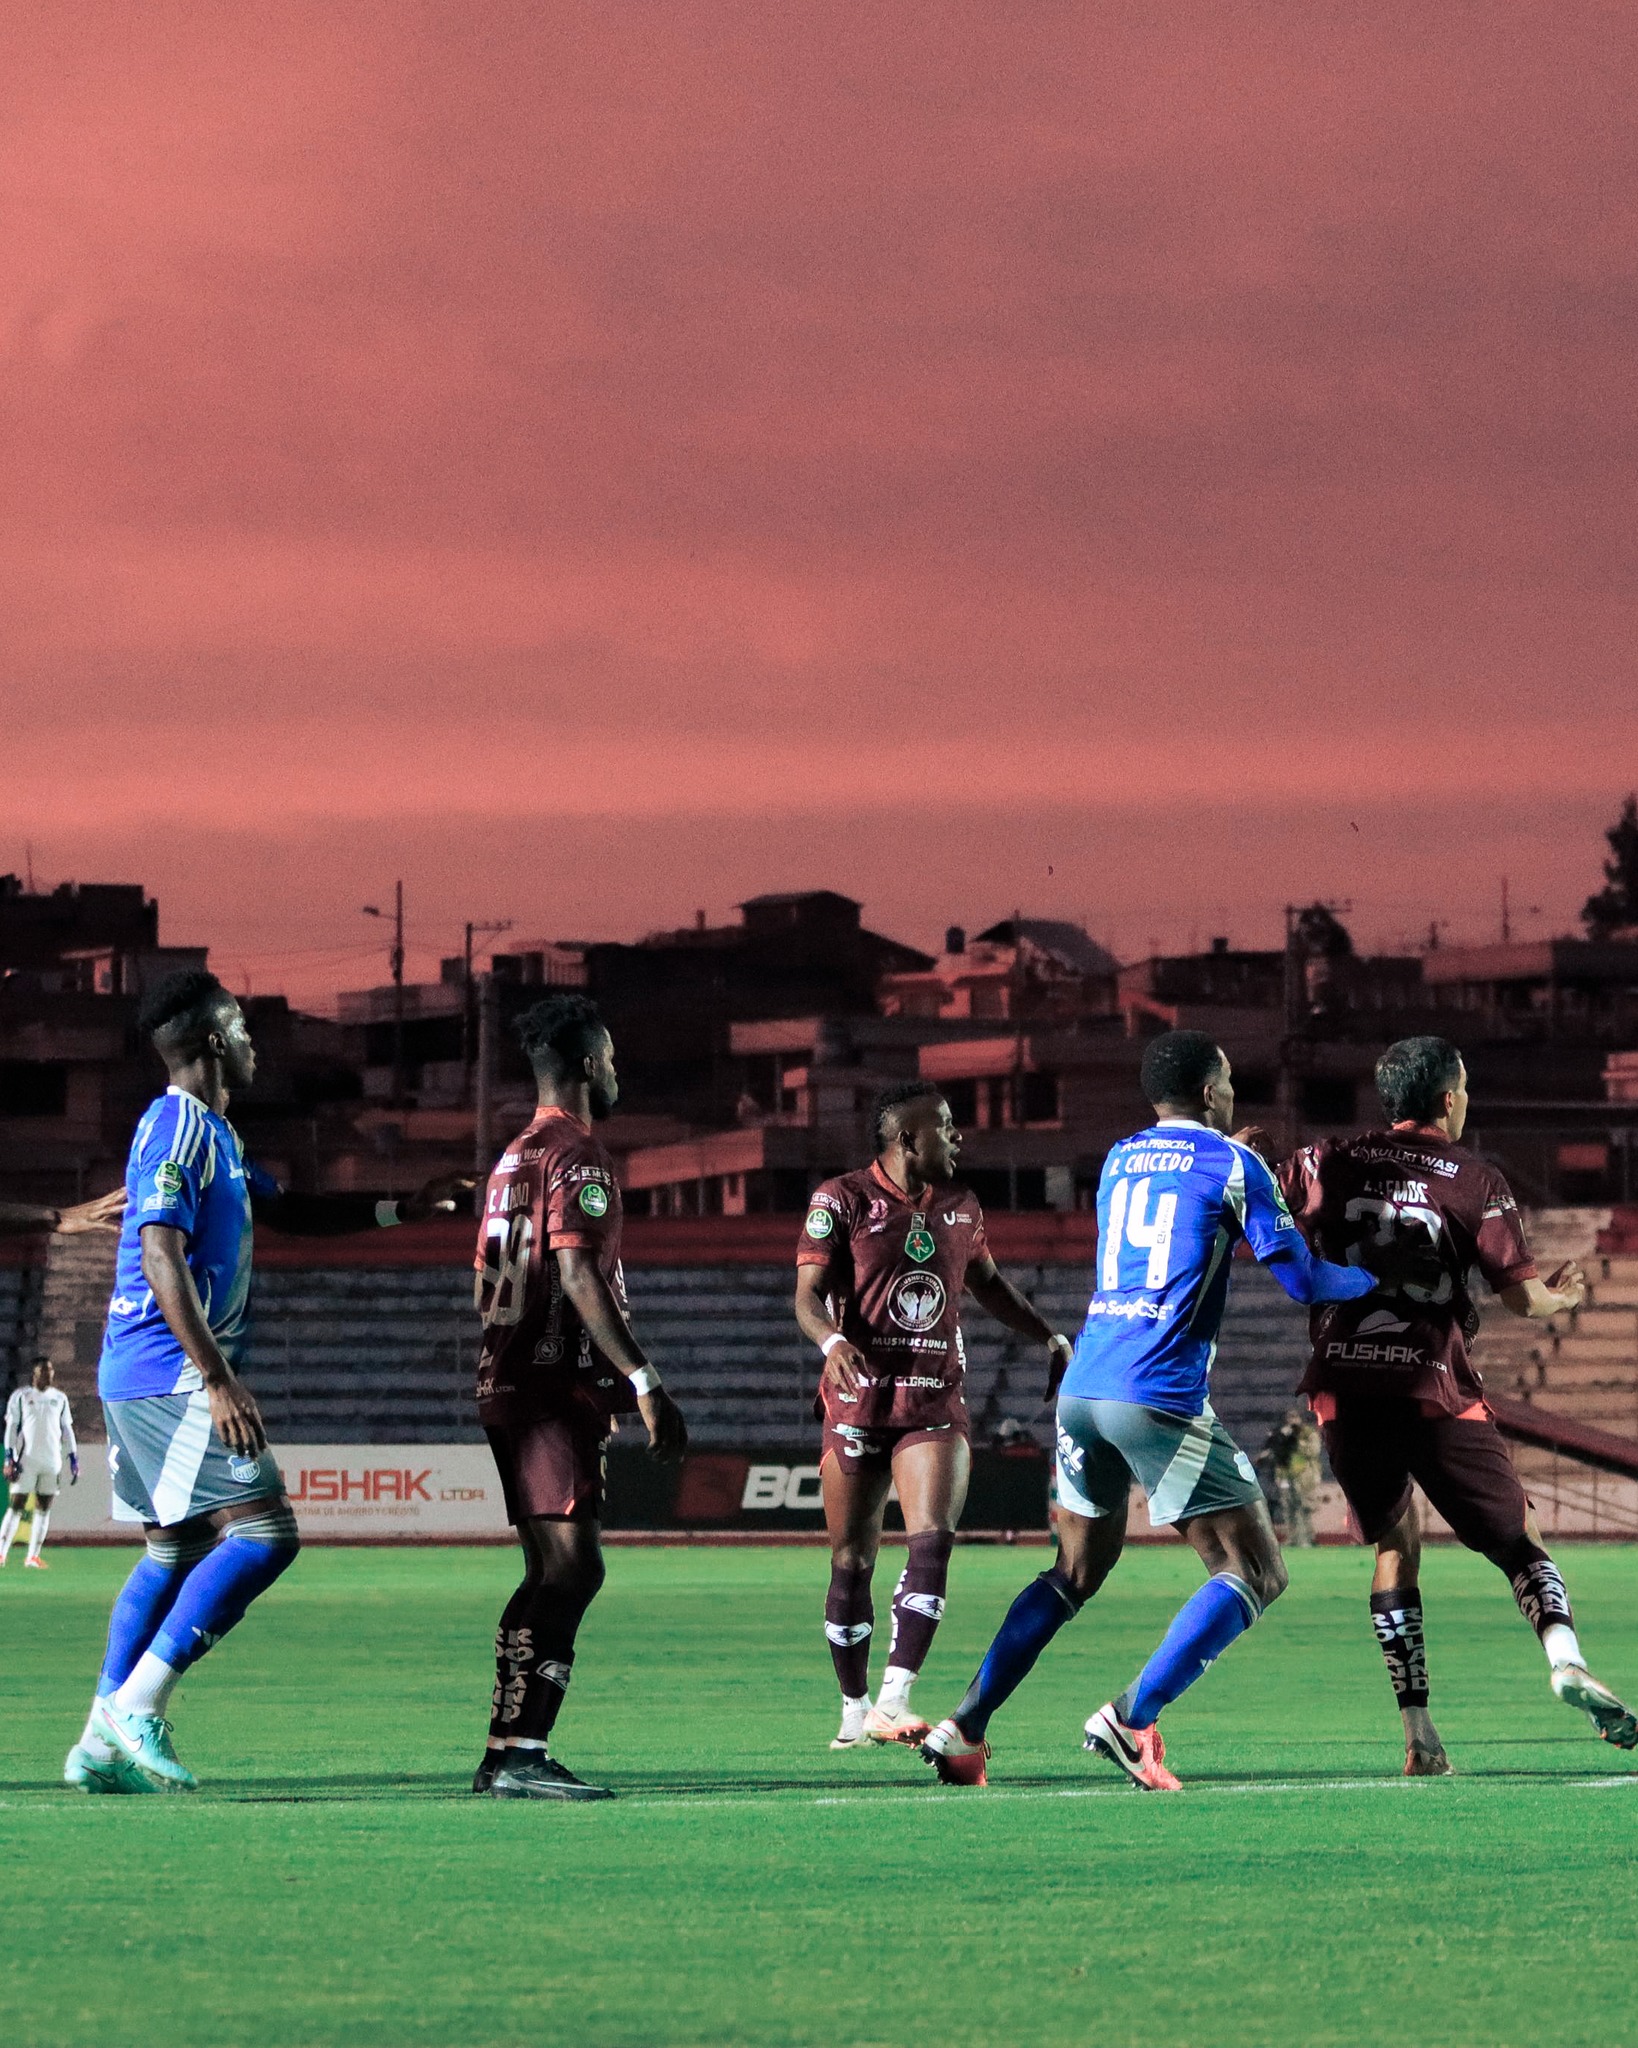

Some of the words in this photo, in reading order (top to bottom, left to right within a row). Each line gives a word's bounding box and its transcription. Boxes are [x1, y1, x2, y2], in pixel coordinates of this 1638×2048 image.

[1125, 1152, 1194, 1173] CAICEDO
[1421, 1155, 1459, 1174] WASI
[1103, 1177, 1178, 1290] 14
[872, 1337, 922, 1348] MUSHUC
[922, 1338, 948, 1350] RUNA
[1325, 1342, 1425, 1365] PUSHAK
[281, 1469, 433, 1501] USHAK
[741, 1465, 824, 1509] BO
[1389, 1607, 1429, 1691] ROLAND
